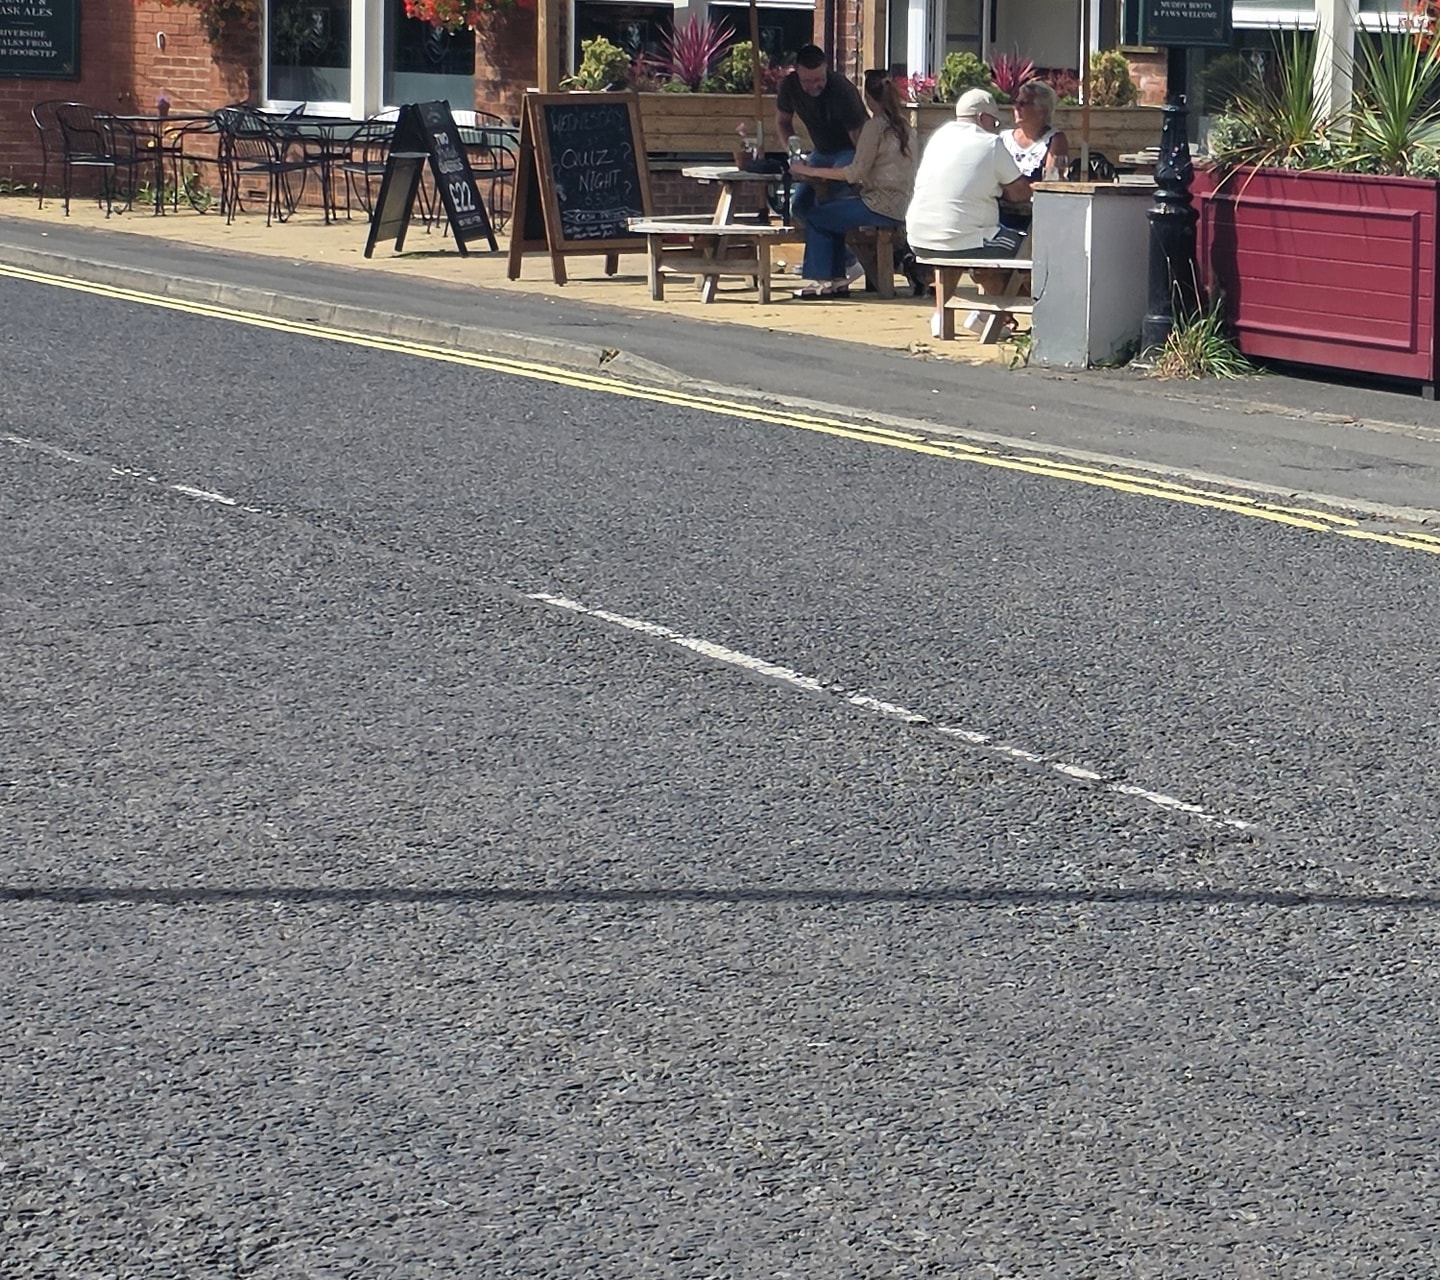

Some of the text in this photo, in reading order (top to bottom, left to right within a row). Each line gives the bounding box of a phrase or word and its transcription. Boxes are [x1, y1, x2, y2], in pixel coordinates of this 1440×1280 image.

[0, 6, 53, 17] ASK ALES
[0, 39, 24, 47] ALKS
[561, 148, 614, 169] QUIZ
[579, 169, 622, 192] NIGHT
